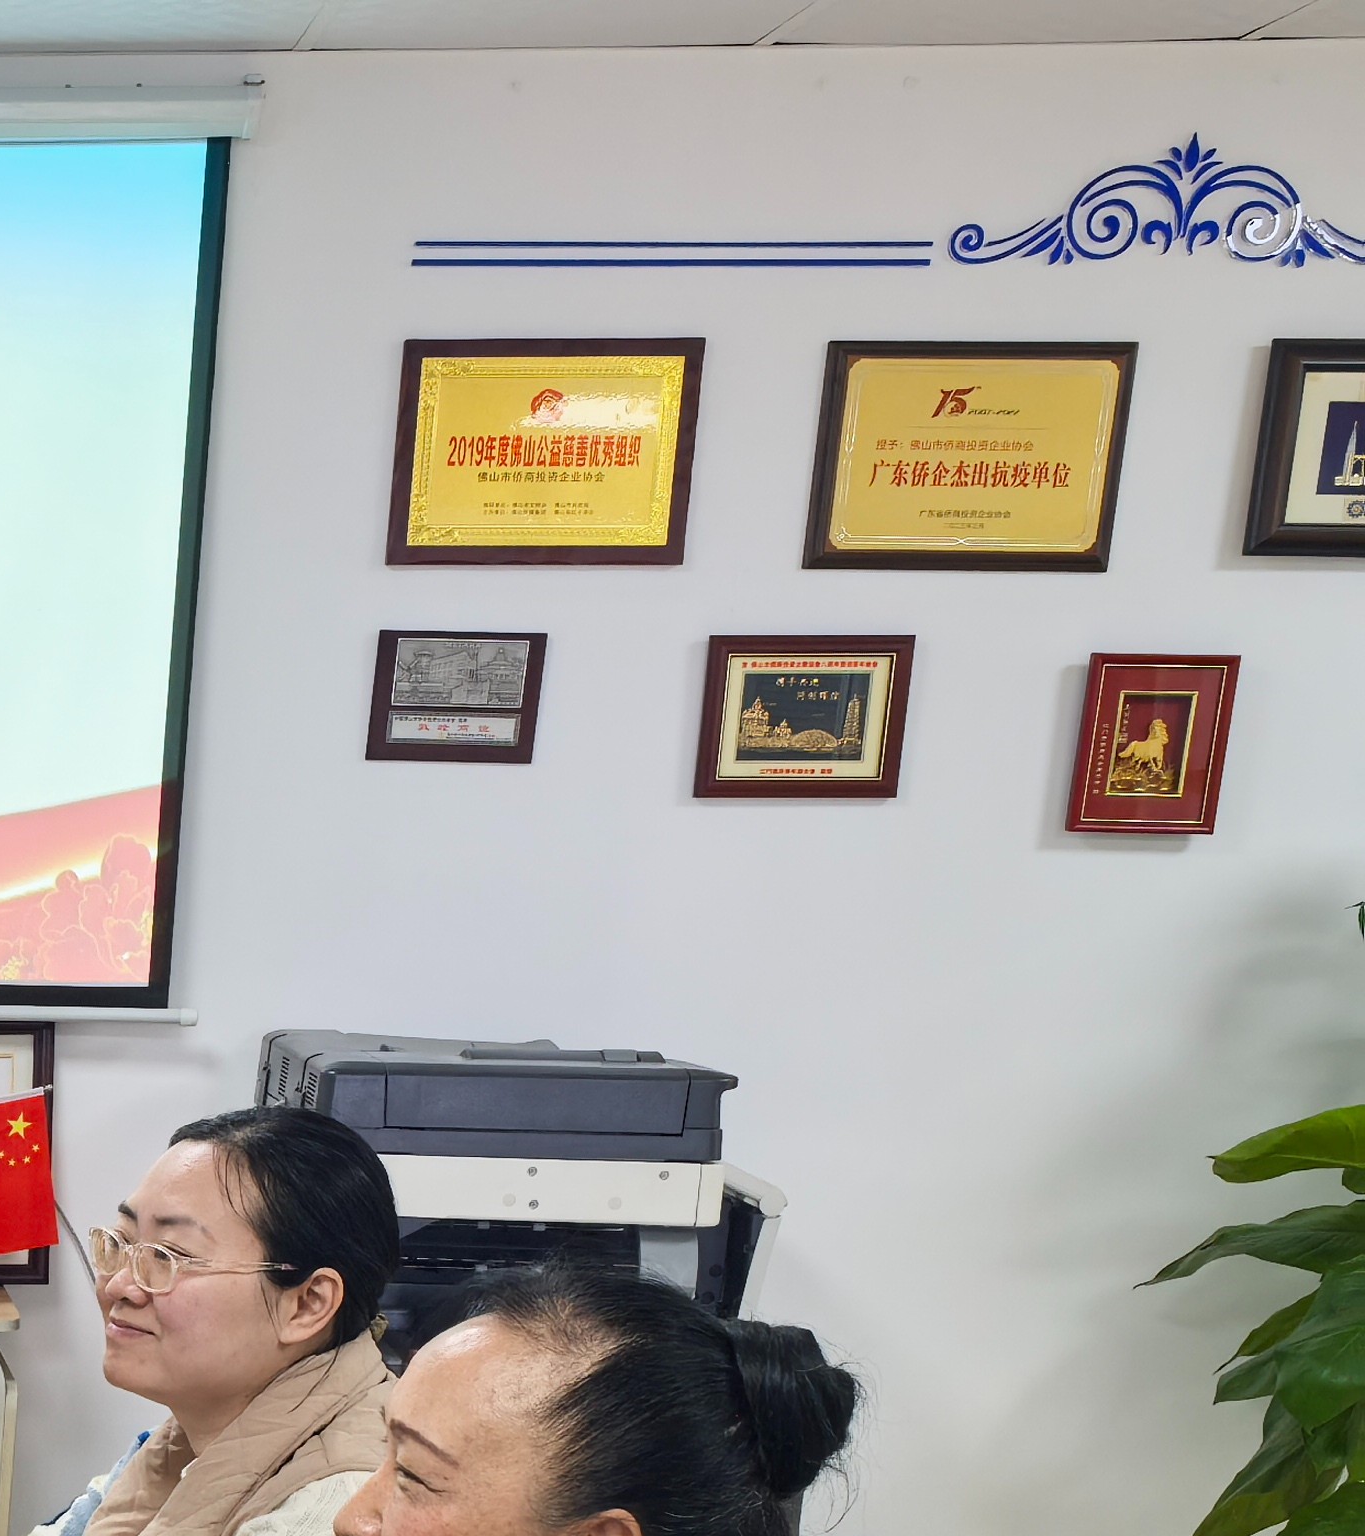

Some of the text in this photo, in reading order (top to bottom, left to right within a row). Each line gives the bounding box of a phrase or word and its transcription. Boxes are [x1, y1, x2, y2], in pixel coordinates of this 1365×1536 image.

[446, 434, 642, 469] 2019年度佛山公益慈善优秀组织
[869, 460, 1071, 489] 广东侨企杰出抗疫单位
